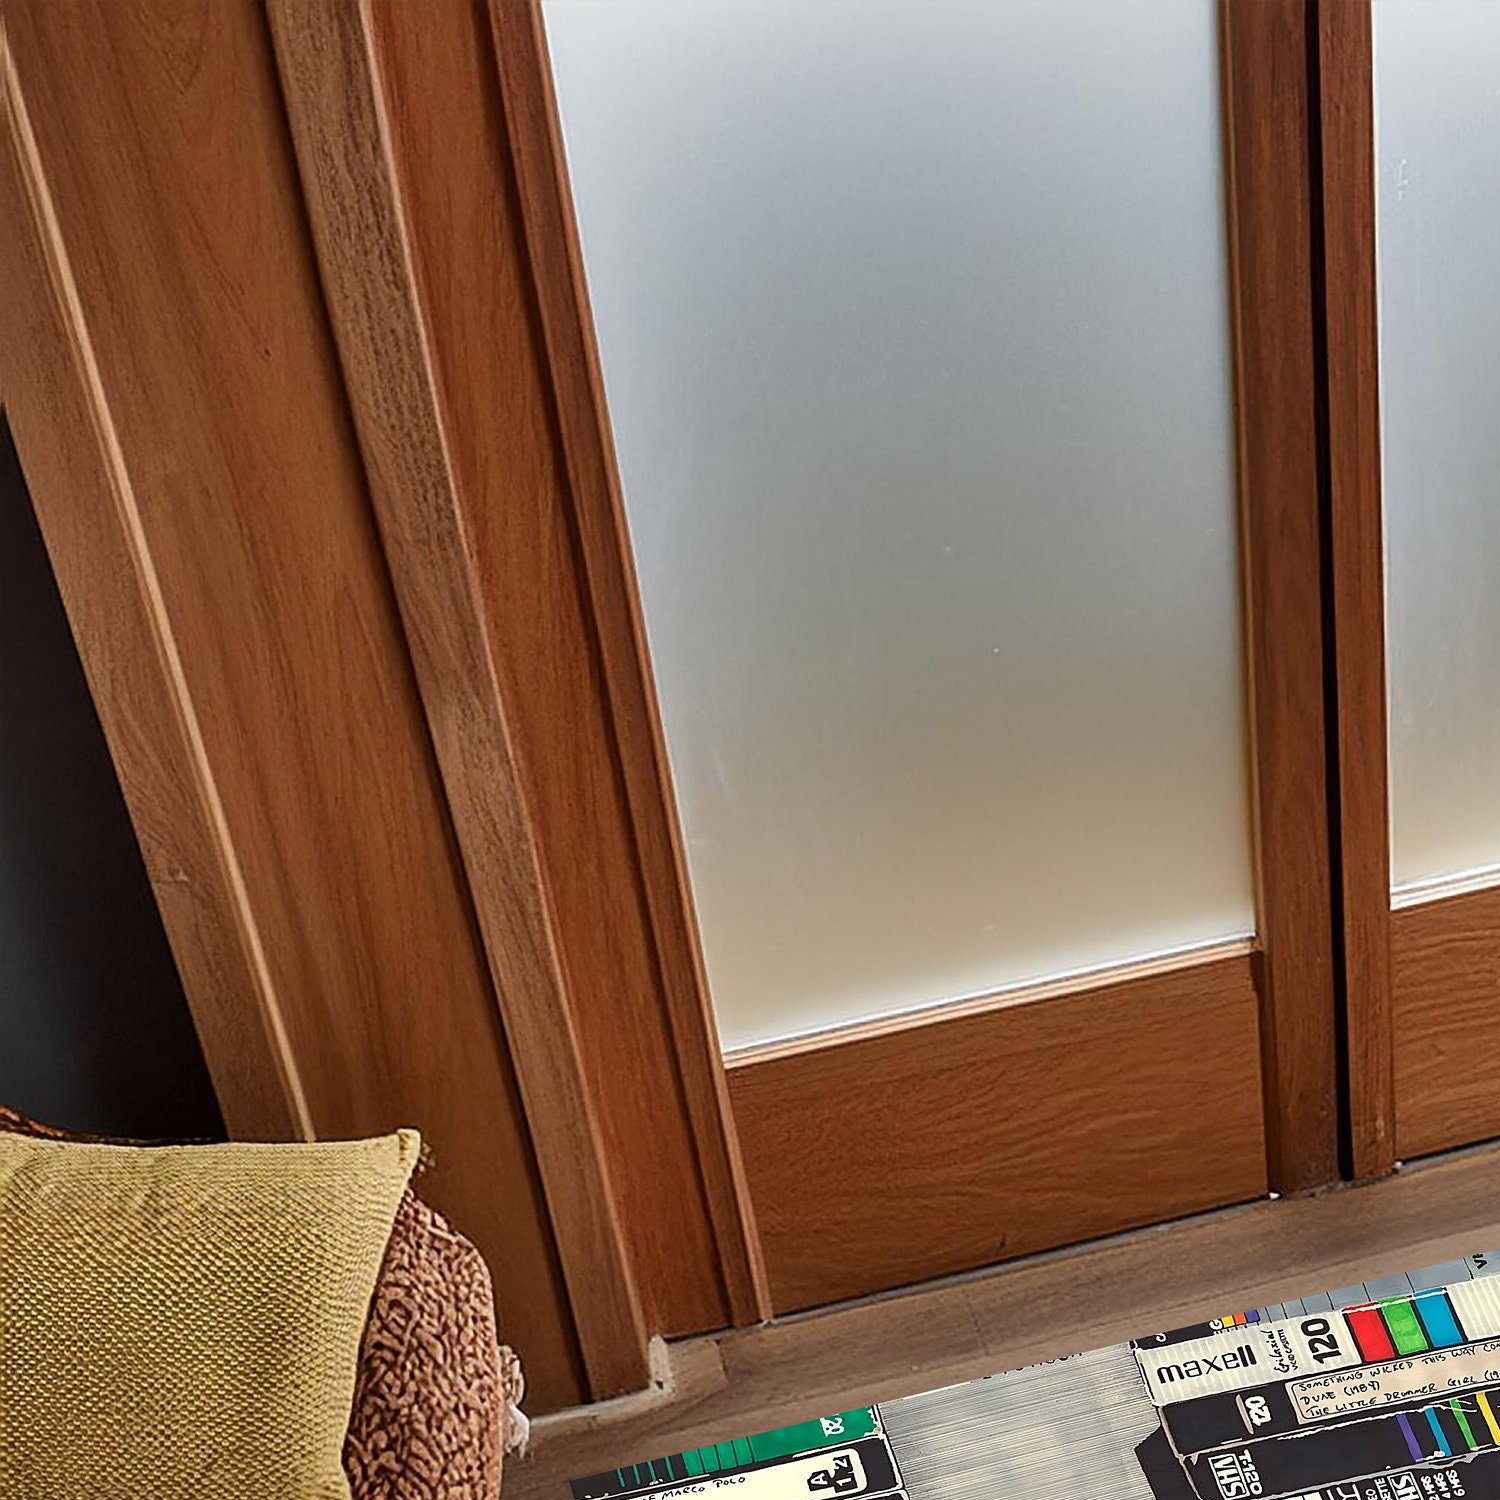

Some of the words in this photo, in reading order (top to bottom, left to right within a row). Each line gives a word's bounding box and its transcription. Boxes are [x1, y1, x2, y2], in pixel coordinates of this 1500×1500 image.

[1156, 1343, 1257, 1384] maxell
[1299, 1317, 1342, 1364] 120
[1297, 1368, 1363, 1392] SOMETHING
[1420, 1353, 1447, 1365] THIS
[1449, 1345, 1476, 1358] WAY
[1209, 1454, 1247, 1499] VHS
[1237, 1448, 1263, 1495] T-120
